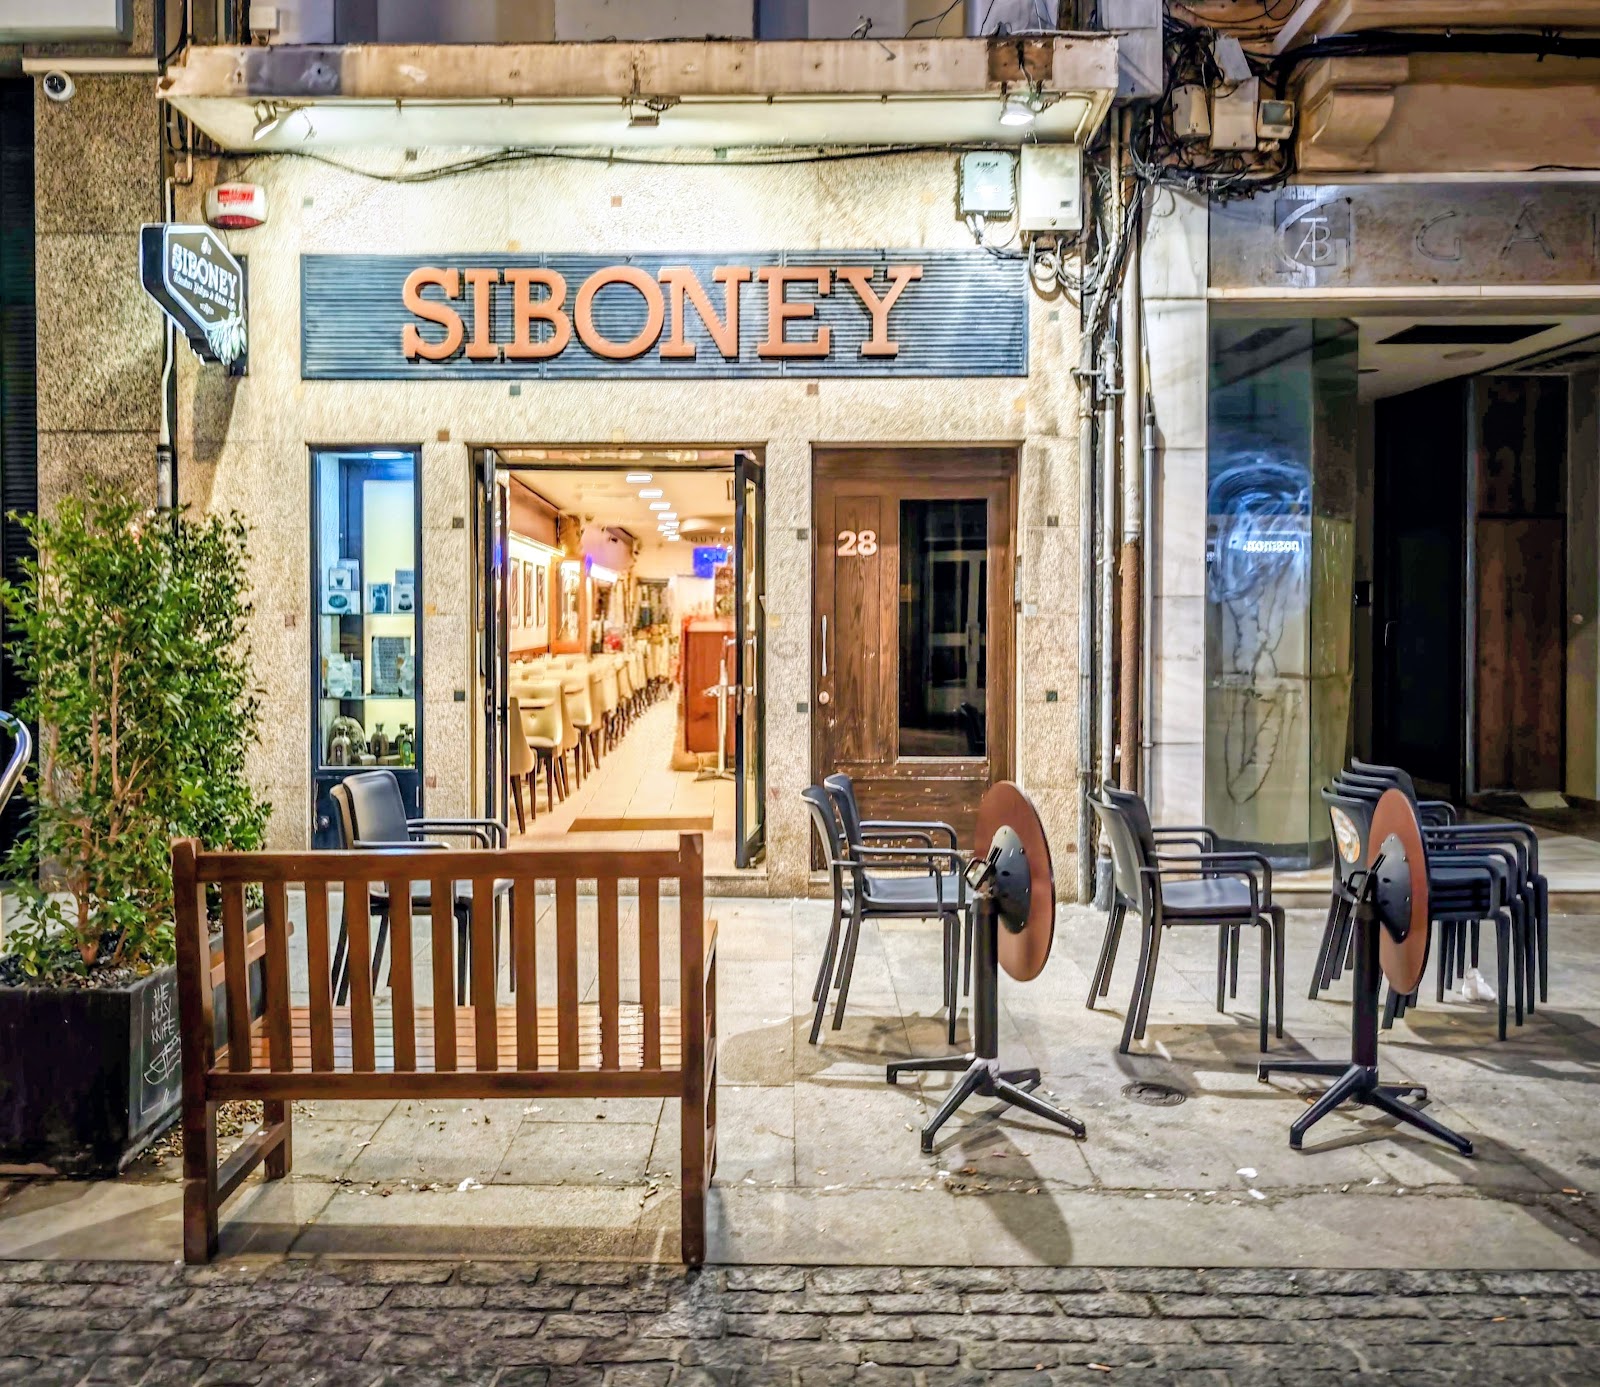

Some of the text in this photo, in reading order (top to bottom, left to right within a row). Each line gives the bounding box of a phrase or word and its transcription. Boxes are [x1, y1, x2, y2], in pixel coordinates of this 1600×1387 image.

[1415, 201, 1600, 261] GA
[172, 242, 238, 300] SIBONEY
[402, 265, 924, 360] SIBONEY
[837, 529, 878, 557] 28
[151, 996, 172, 1025] HOLY
[151, 1017, 177, 1045] KNIFE
